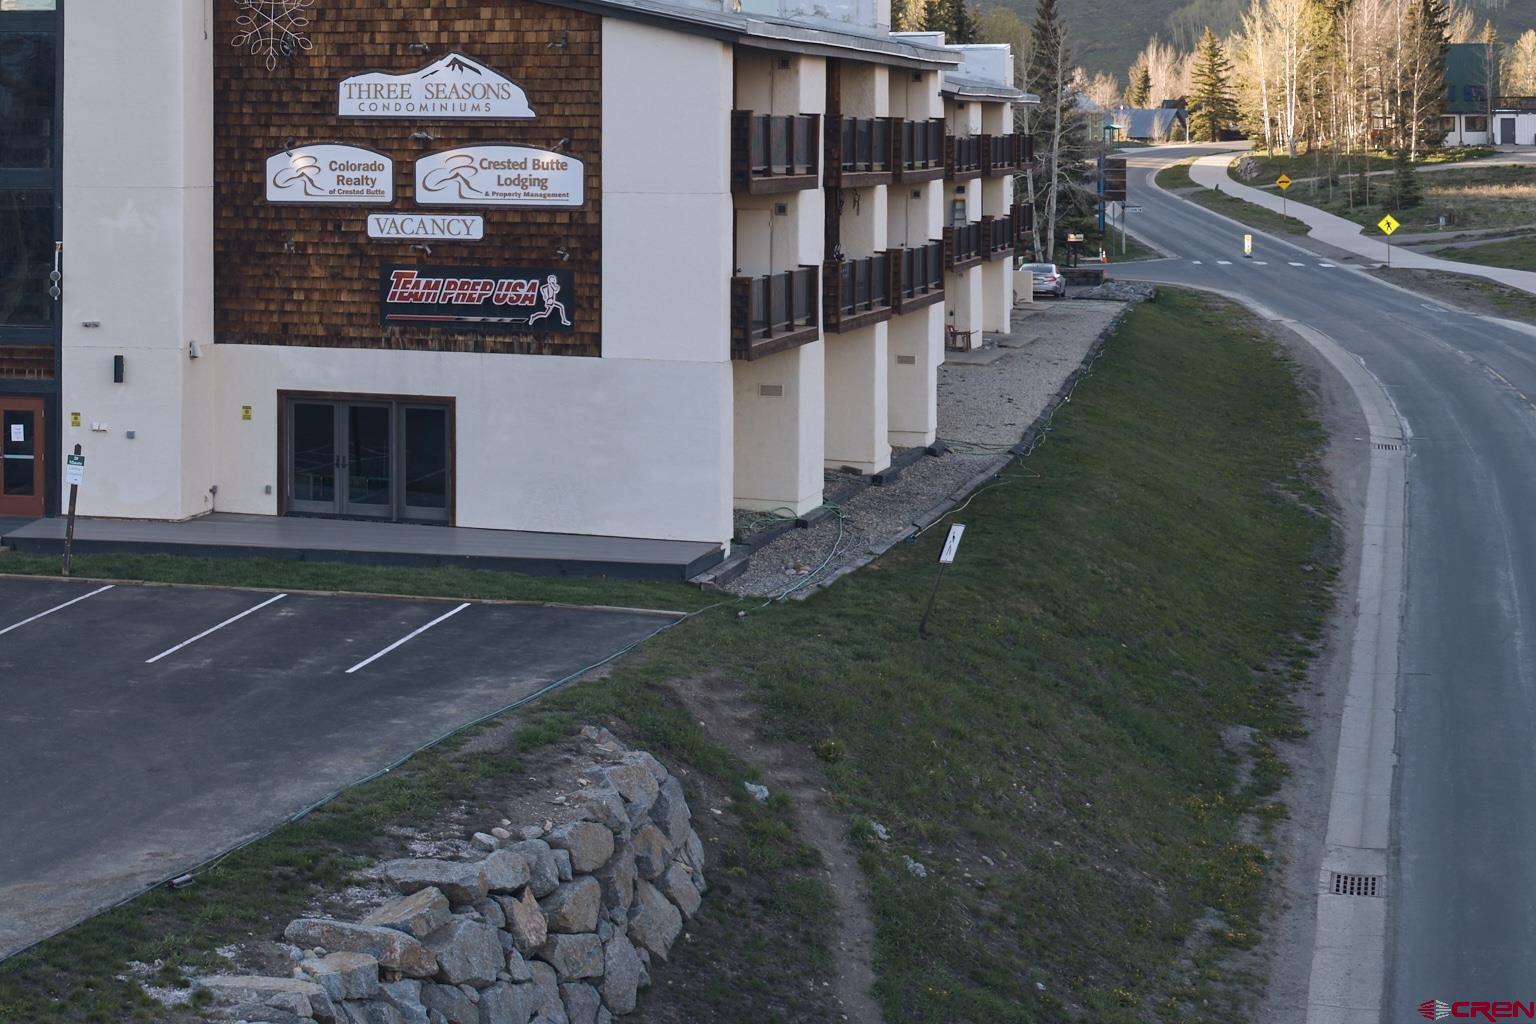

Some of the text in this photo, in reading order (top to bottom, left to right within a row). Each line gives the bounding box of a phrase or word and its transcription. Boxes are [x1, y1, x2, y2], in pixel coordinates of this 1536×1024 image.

[343, 82, 511, 100] THREE SEASONS
[358, 102, 492, 113] CONDOMINIUMS
[328, 160, 385, 172] Colorado
[479, 157, 569, 171] Crested Butte
[336, 174, 377, 189] Realty
[497, 173, 549, 190] Lodging
[523, 191, 570, 199] Management
[374, 217, 476, 236] VACANCY
[439, 278, 496, 305] PREP
[493, 279, 540, 306] USA
